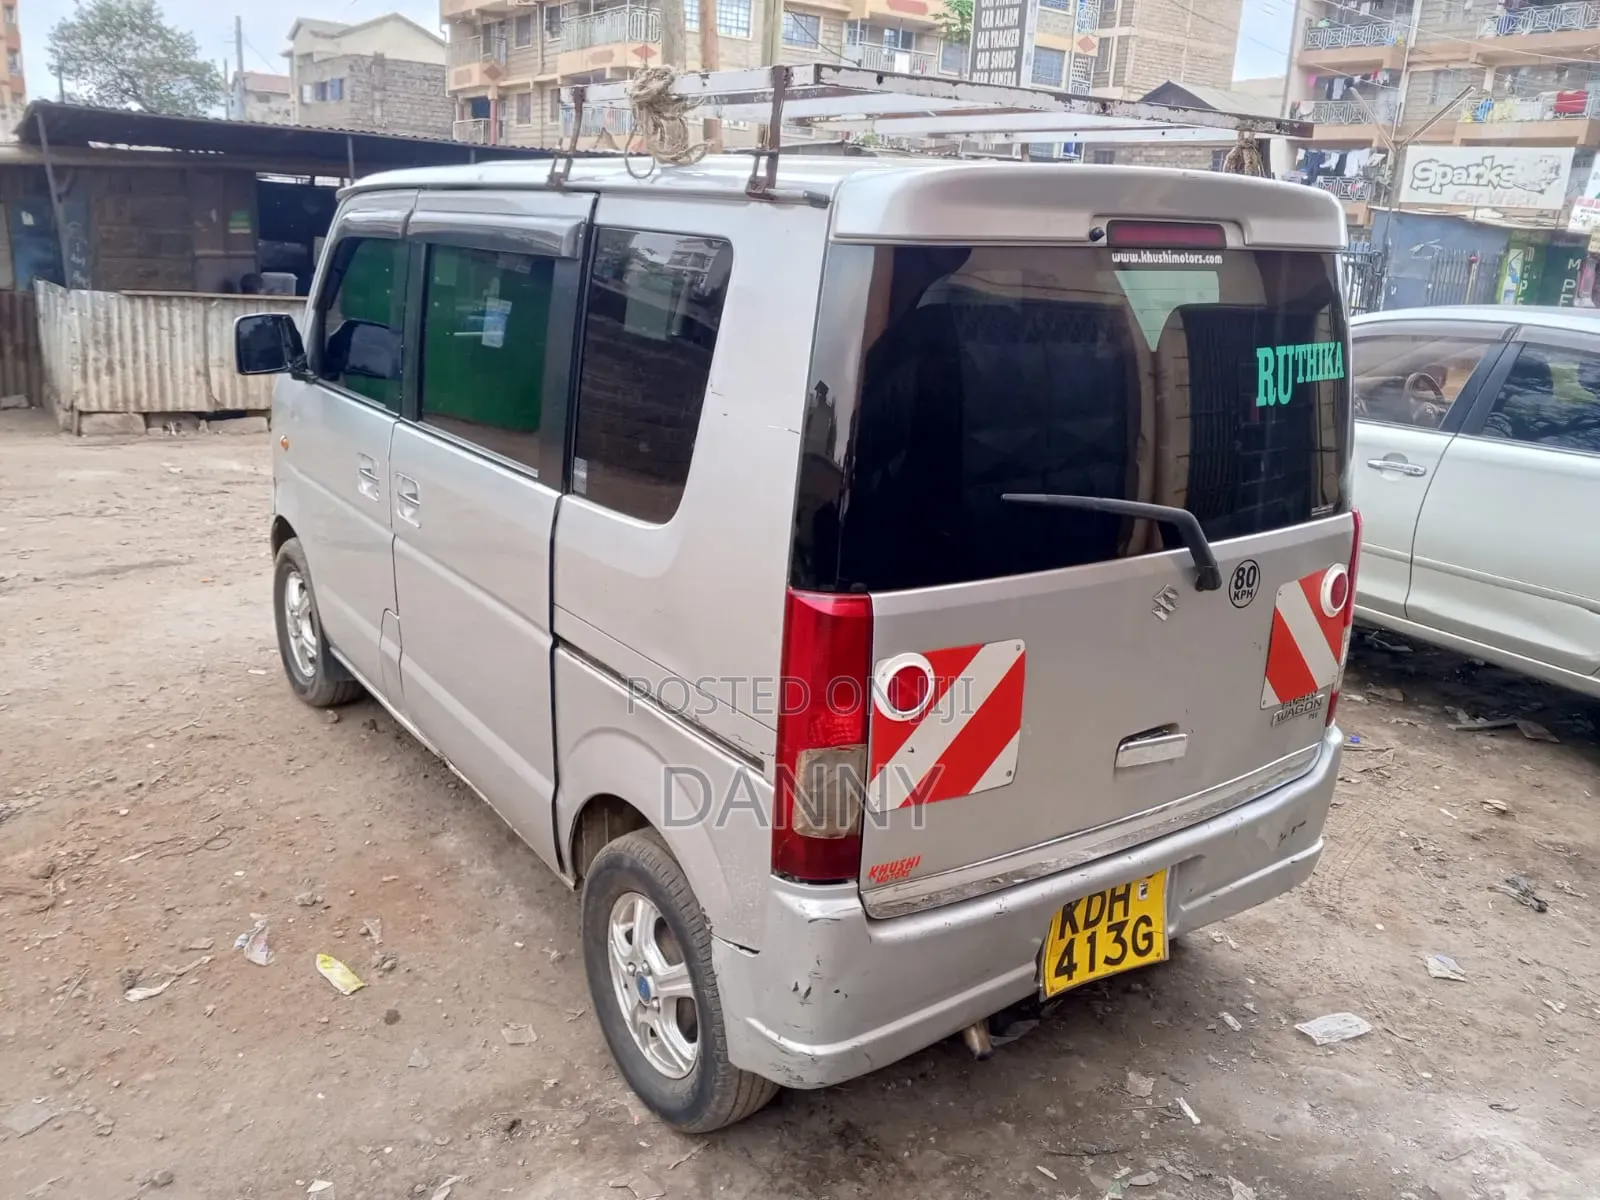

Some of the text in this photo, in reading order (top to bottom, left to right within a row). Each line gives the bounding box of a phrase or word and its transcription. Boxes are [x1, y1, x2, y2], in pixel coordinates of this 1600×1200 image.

[1111, 250, 1223, 265] www.khushimotors.com
[1234, 565, 1256, 590] 80
[1233, 588, 1254, 601] KPH
[1276, 699, 1321, 722] WAGON
[868, 855, 921, 879] KHUSHI
[1059, 883, 1131, 940] KDH
[1054, 914, 1154, 981] 413G
